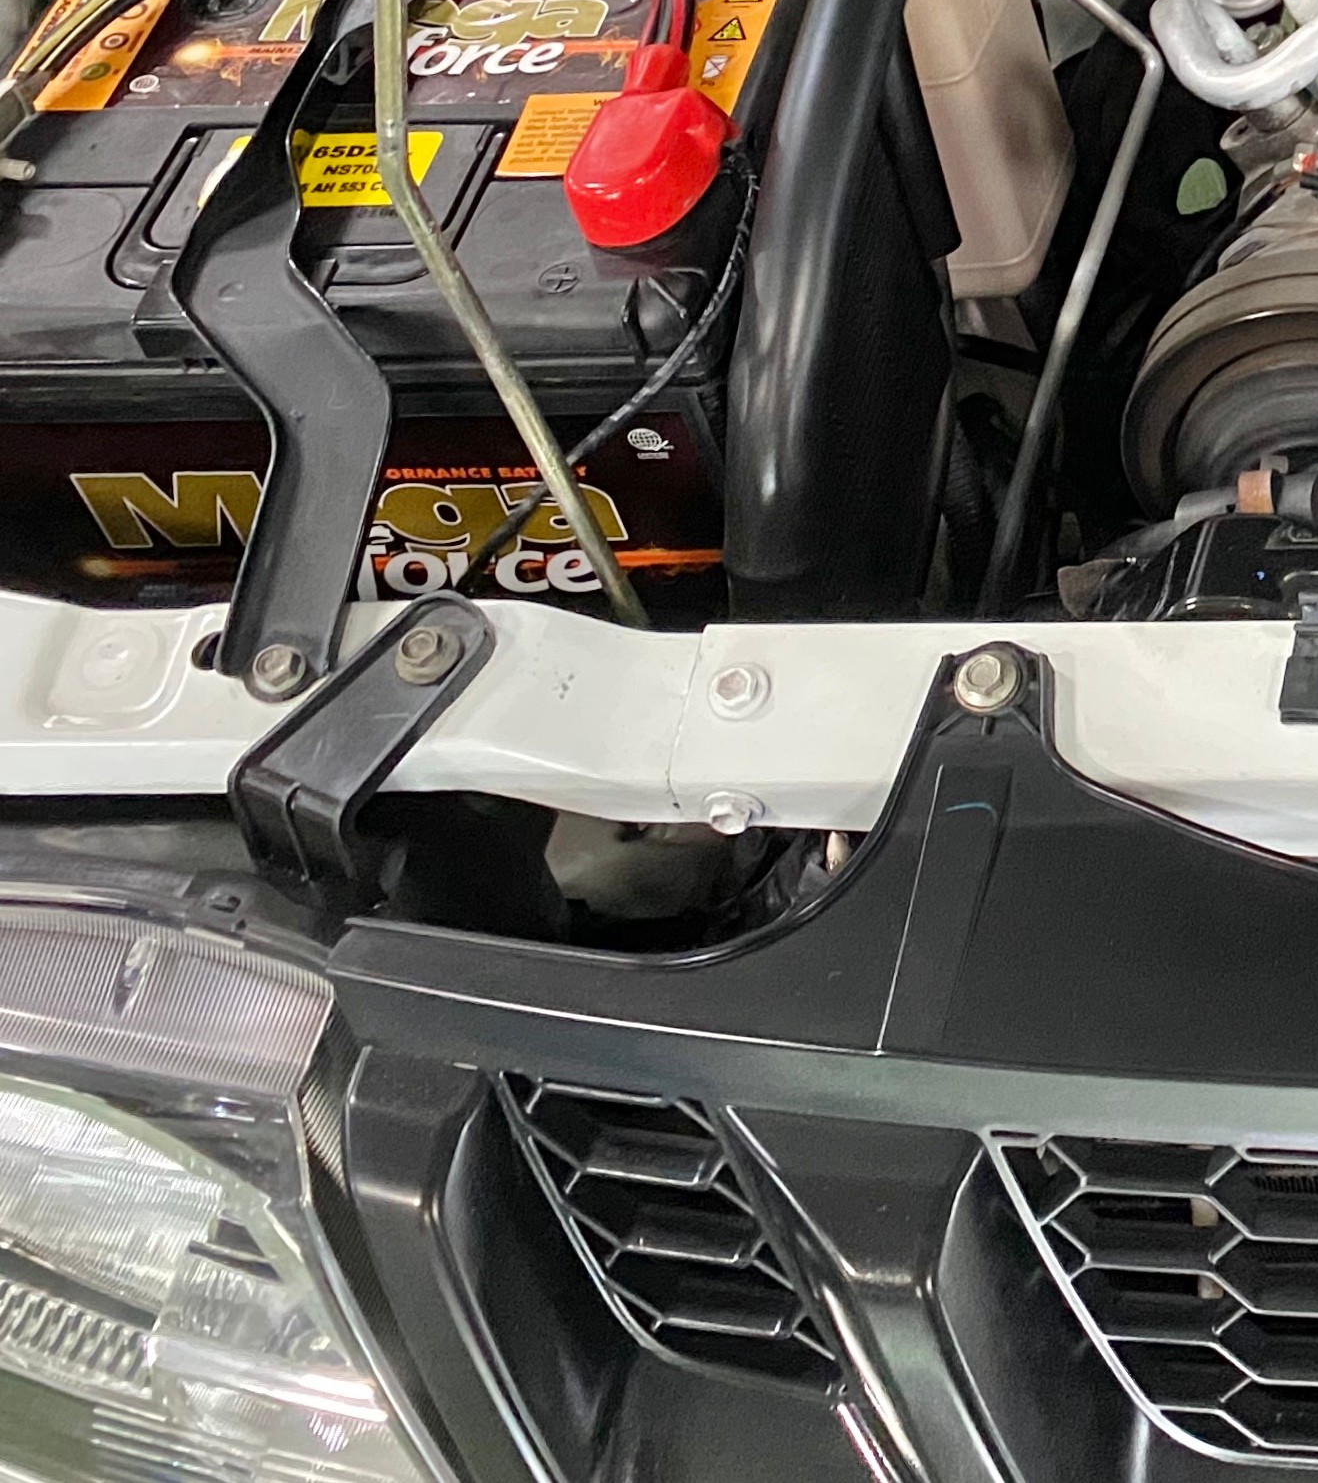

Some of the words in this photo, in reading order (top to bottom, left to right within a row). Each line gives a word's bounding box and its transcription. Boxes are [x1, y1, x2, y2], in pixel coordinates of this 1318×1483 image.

[407, 24, 566, 77] force
[312, 145, 378, 159] 65D2
[311, 182, 336, 194] AH
[338, 181, 367, 193] 553
[384, 466, 493, 480] ORMANCE
[68, 470, 629, 560] Mga
